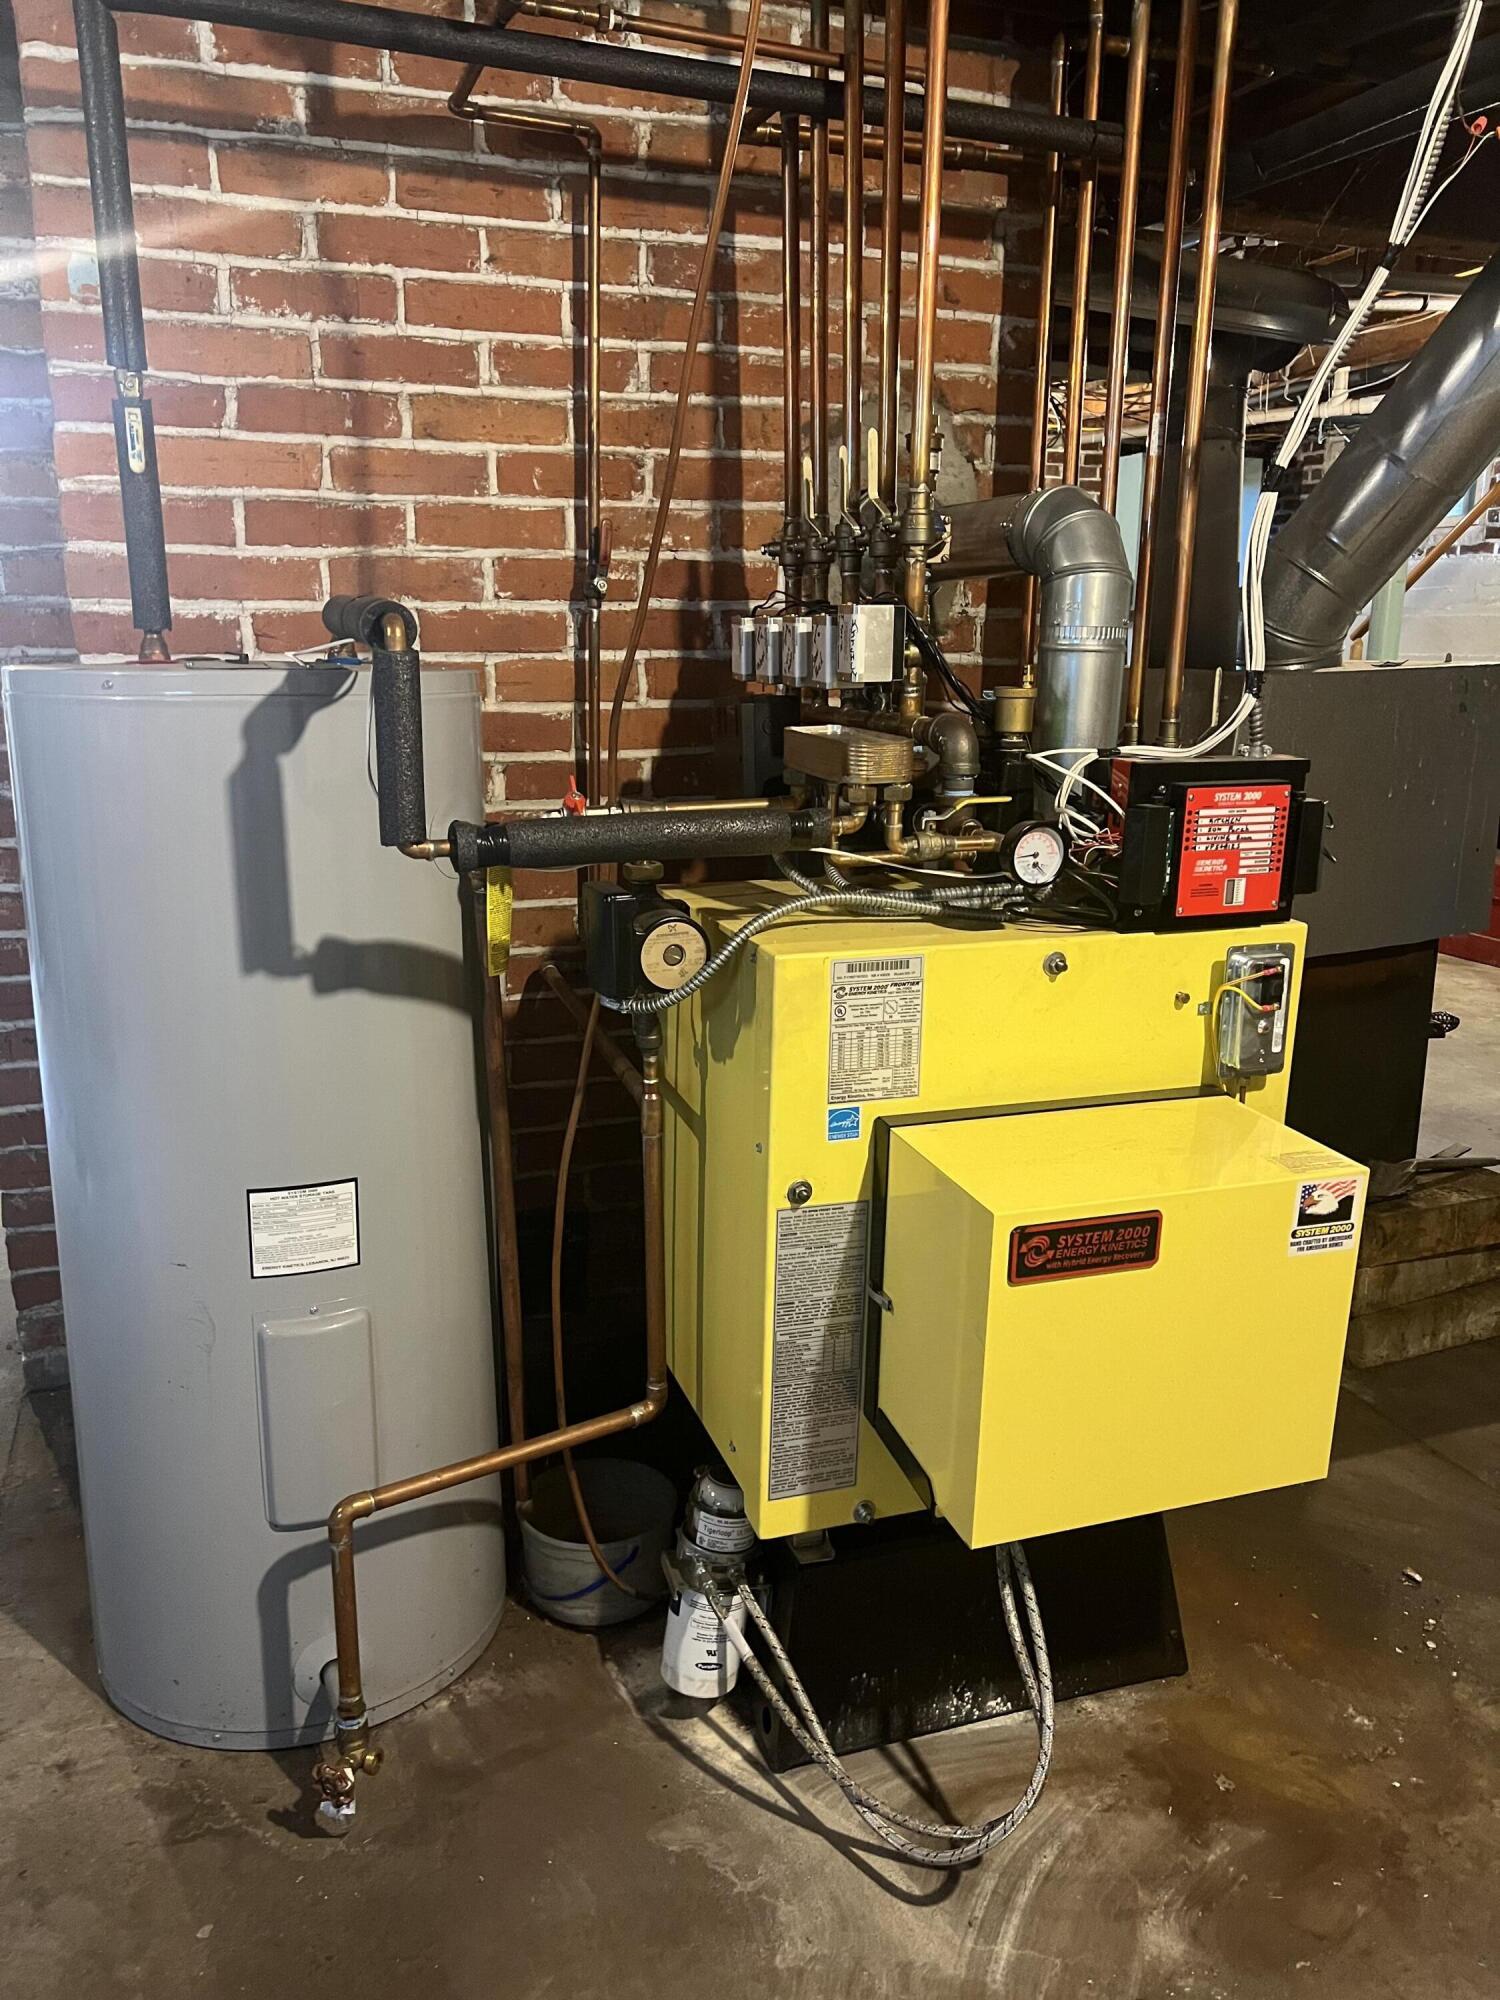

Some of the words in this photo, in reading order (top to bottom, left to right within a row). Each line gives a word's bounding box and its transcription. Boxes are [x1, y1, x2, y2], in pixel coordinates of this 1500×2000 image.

[1214, 792, 1242, 802] SYSTEM
[1244, 792, 1263, 801] 2000
[1058, 1230, 1114, 1248] SYSTEM
[1116, 1227, 1150, 1240] 2000
[1295, 1227, 1329, 1238] SYSTEM
[1330, 1224, 1352, 1234] 2000
[1056, 1246, 1099, 1259] ENERGY
[1101, 1240, 1147, 1252] KINETICS
[1047, 1261, 1062, 1269] with
[1063, 1259, 1085, 1269] Hybrid
[1087, 1255, 1111, 1265] Energy
[1114, 1252, 1145, 1261] Recovery
